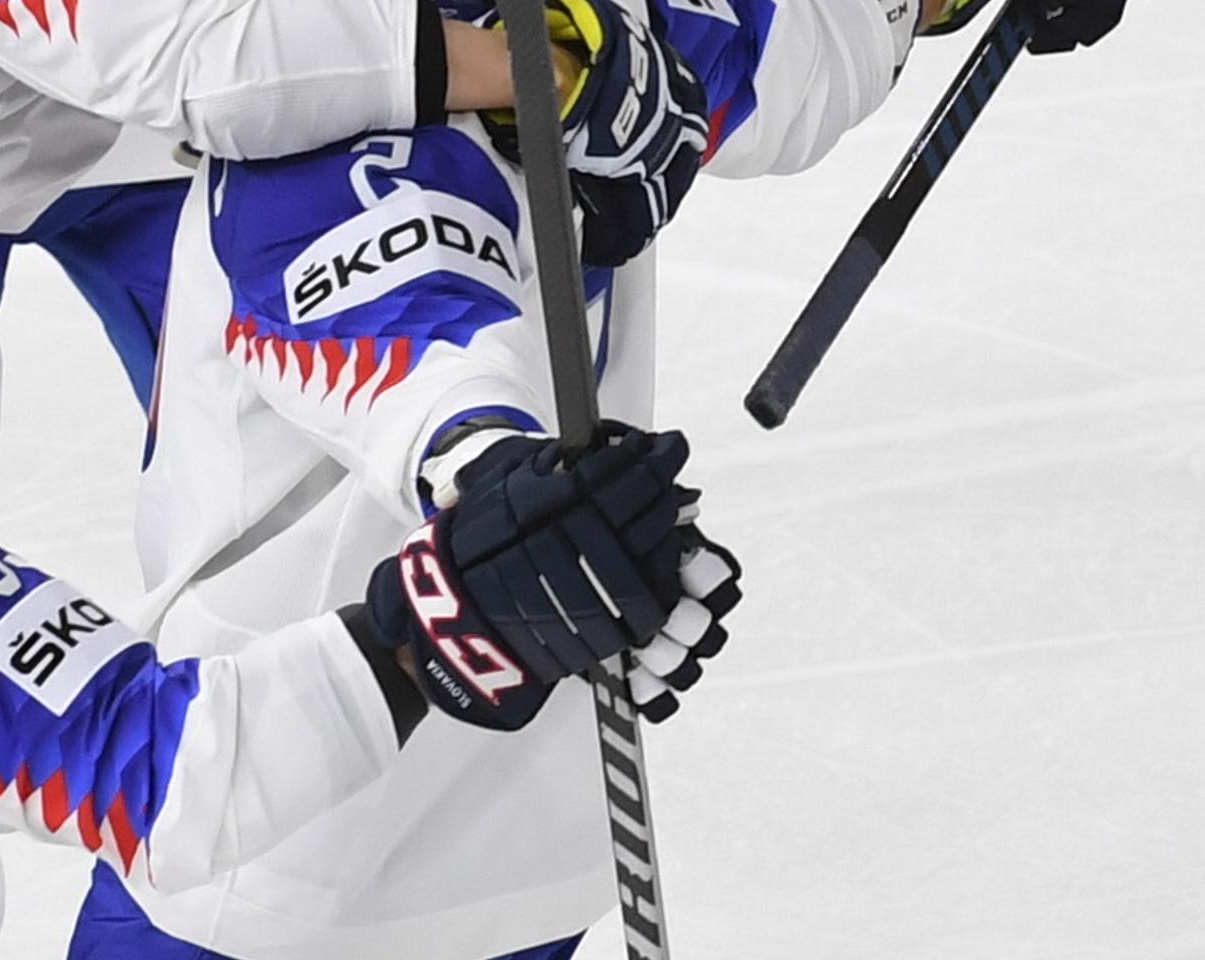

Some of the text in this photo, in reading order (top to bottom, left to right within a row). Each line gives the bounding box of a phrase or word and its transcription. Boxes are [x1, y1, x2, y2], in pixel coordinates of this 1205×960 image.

[885, 0, 908, 24] CM
[293, 214, 517, 320] ŠKODA
[425, 658, 473, 709] SLOVAKIA
[591, 660, 664, 960] RIOR
